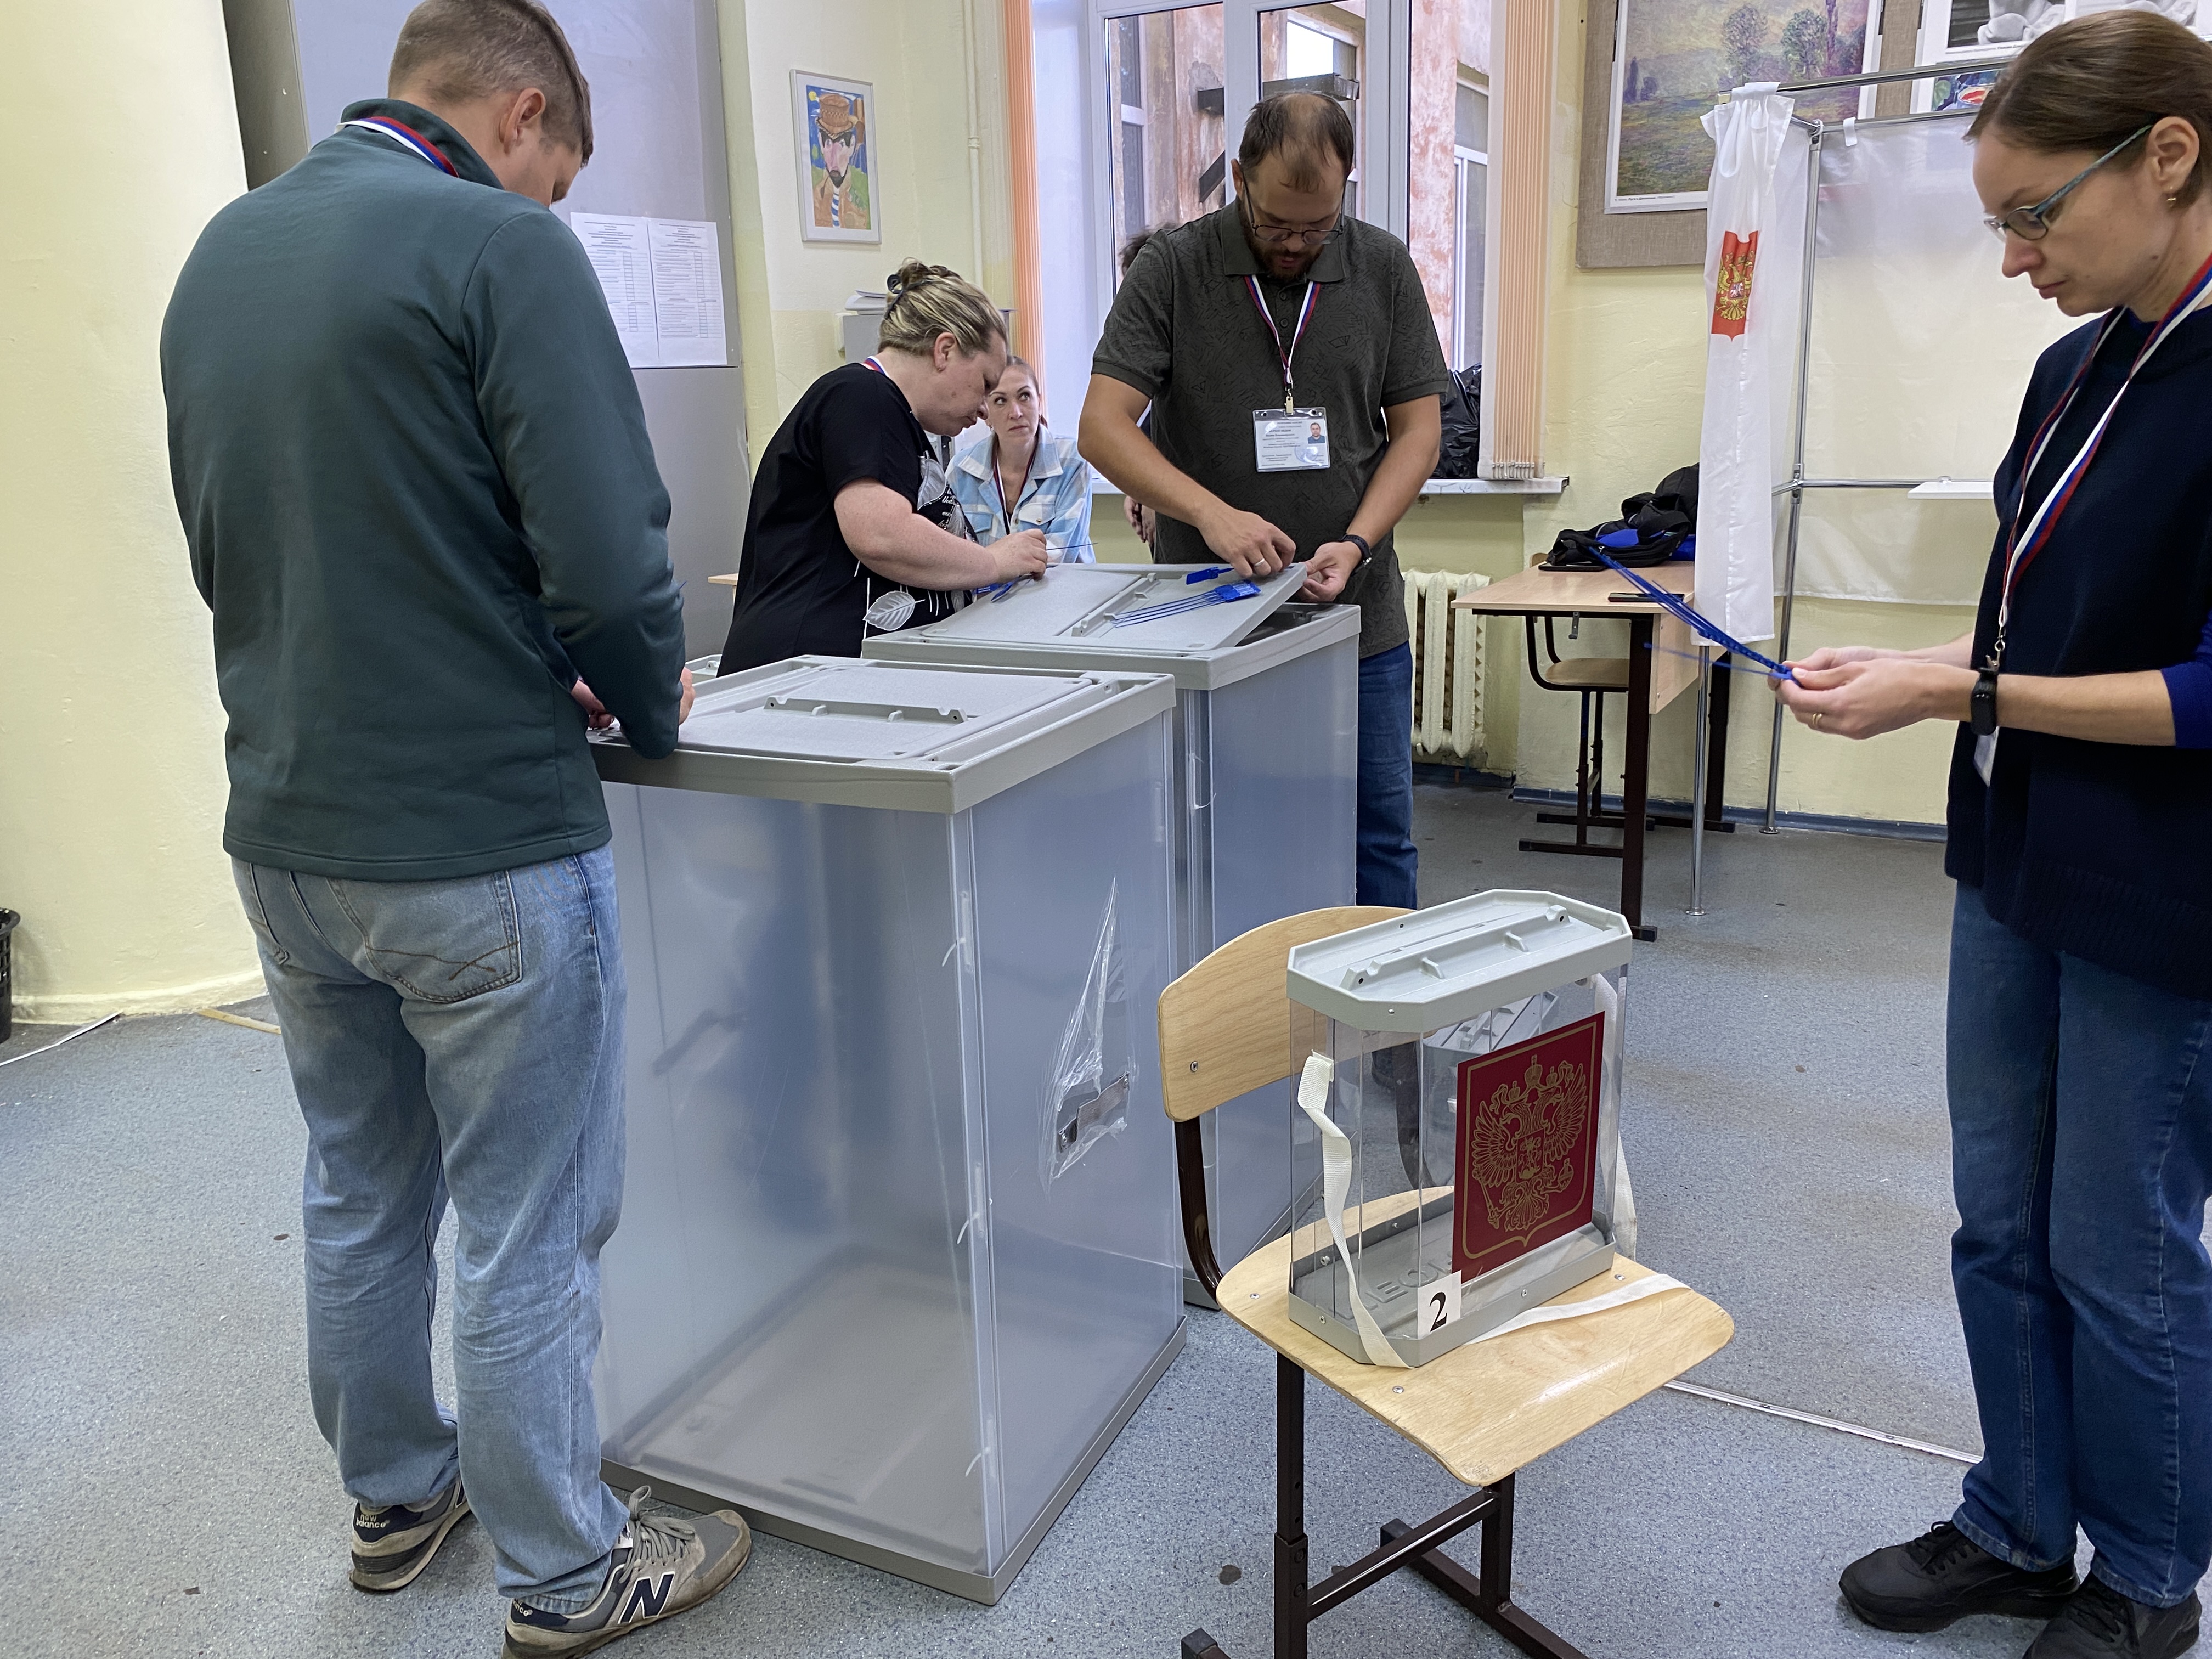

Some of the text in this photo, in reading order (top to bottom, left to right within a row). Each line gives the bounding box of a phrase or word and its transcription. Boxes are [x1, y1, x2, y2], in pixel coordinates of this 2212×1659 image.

[1429, 1291, 1448, 1333] 2
[356, 1517, 386, 1528] balance
[360, 1514, 377, 1522] new
[618, 1571, 675, 1624] N
